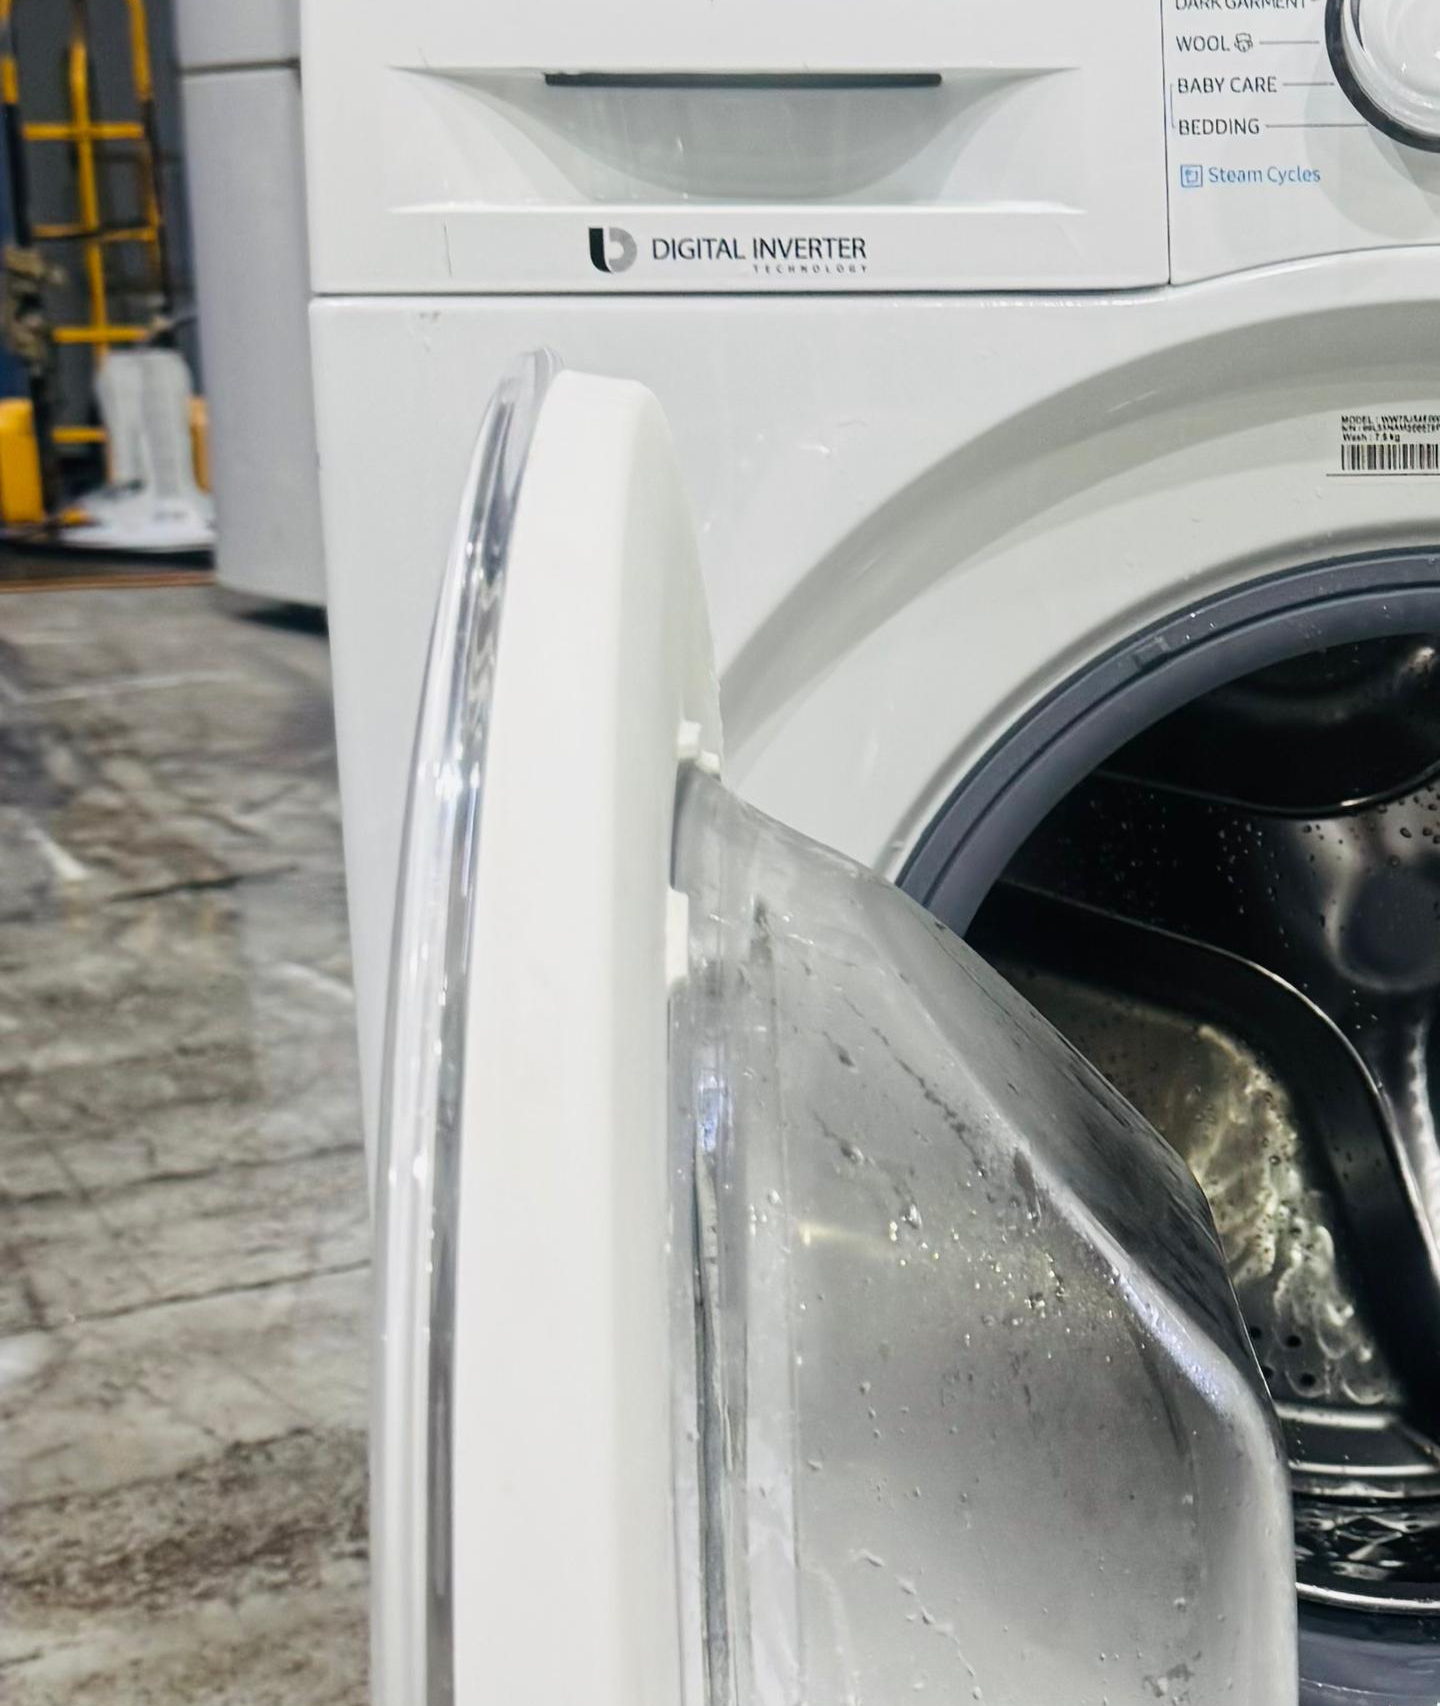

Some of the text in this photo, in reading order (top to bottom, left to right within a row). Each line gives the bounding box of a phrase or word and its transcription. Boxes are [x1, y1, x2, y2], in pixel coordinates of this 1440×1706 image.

[1176, 35, 1231, 52] WOOL
[1178, 76, 1278, 94] BABY CARE
[1179, 118, 1260, 135] BEDDING
[1208, 165, 1321, 186] Steam Cycles
[651, 236, 868, 261] DIGITAL INVERTER
[752, 263, 868, 274] TECHNOLOGY
